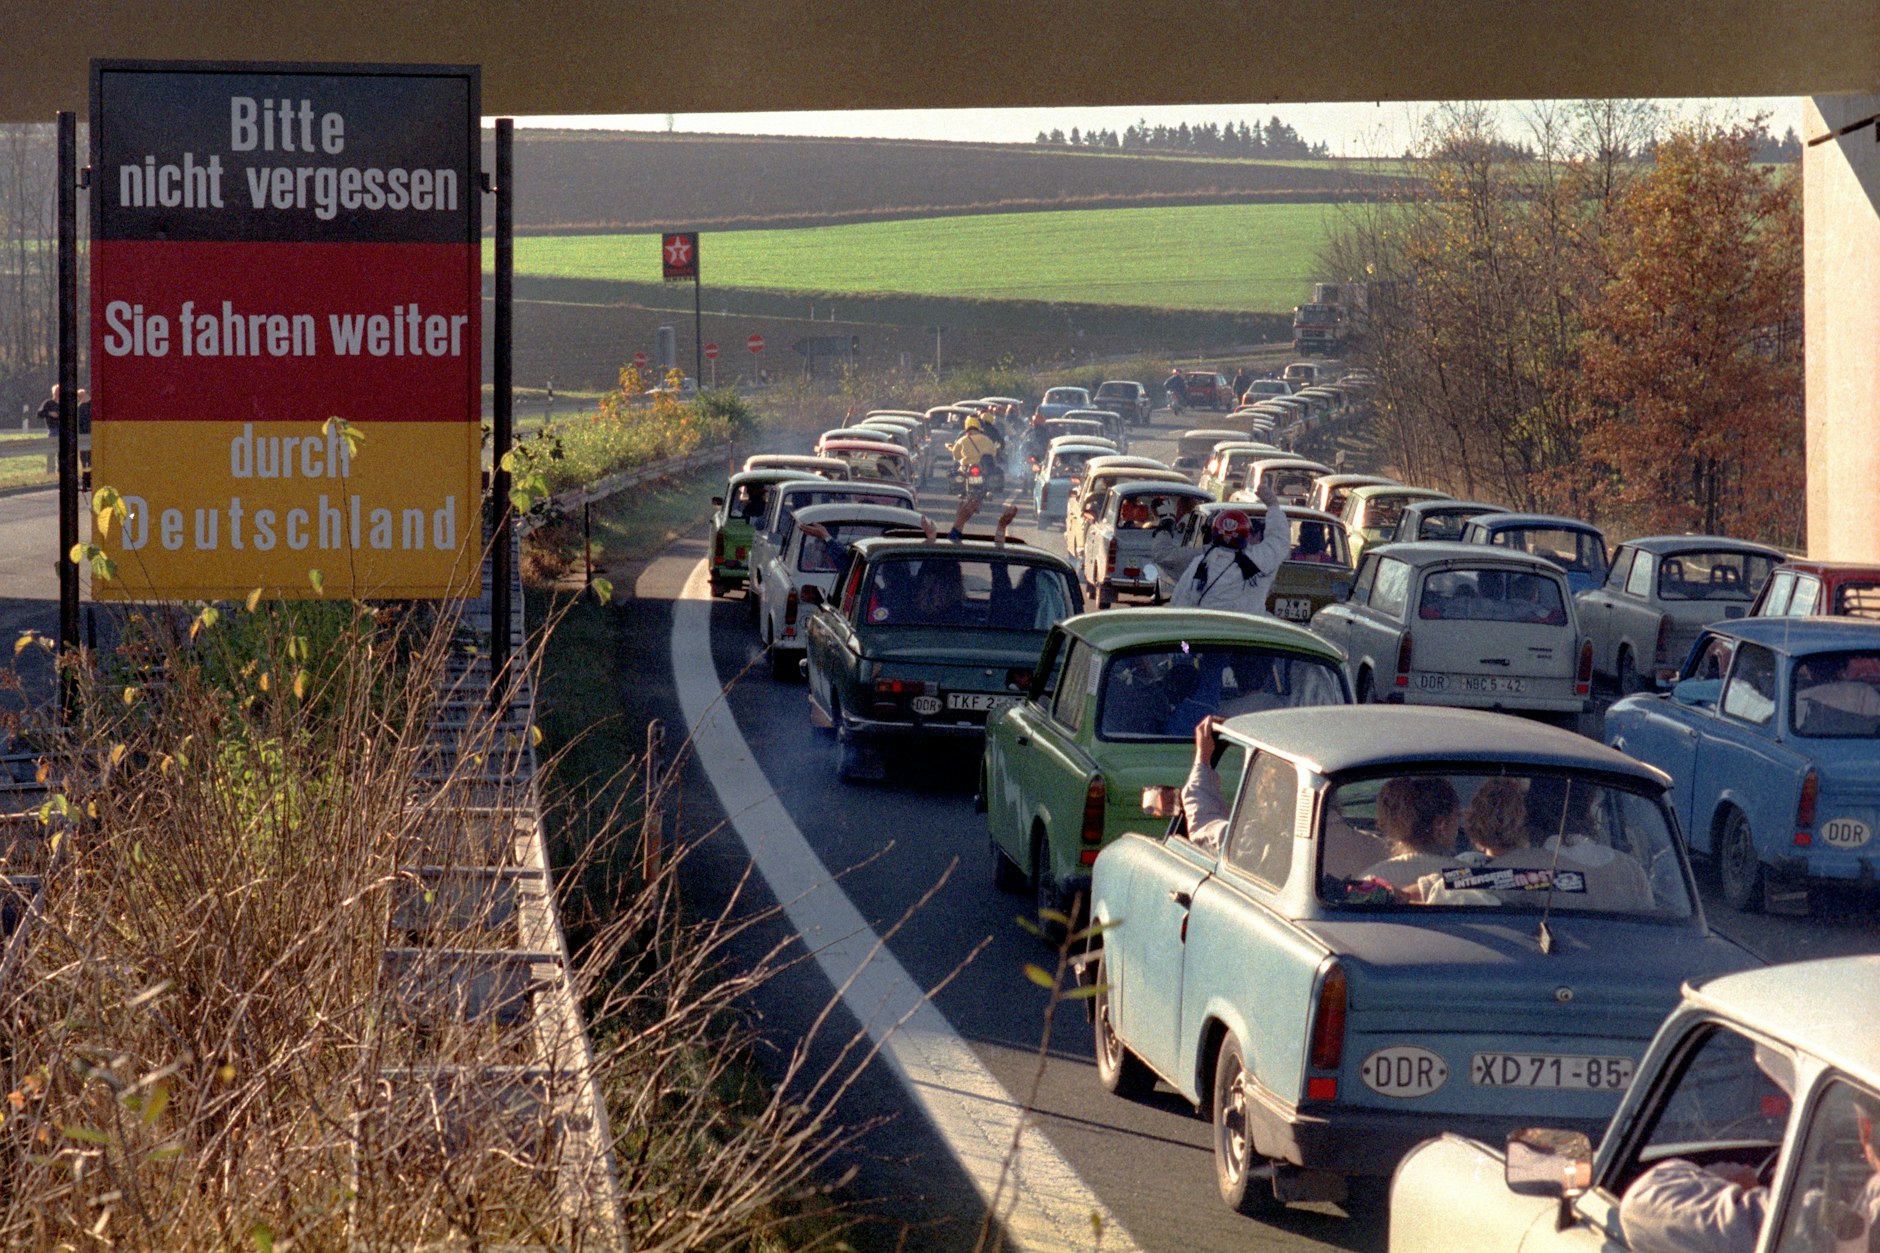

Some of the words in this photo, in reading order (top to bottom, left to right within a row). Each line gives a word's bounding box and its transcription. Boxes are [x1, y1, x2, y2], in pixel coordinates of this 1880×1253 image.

[231, 96, 345, 154] Bitte
[119, 152, 224, 208] nicht
[246, 166, 458, 220] vergessen
[104, 300, 170, 357] Sie
[179, 300, 316, 357] fahren
[328, 303, 468, 357] weiter
[230, 423, 351, 479] durch
[121, 495, 456, 551] Deutschland
[1420, 676, 1446, 690] DDR
[915, 700, 937, 711] DDR
[952, 694, 979, 708] TKF
[1828, 823, 1864, 843] DDR
[1375, 1056, 1434, 1088] DDR
[1479, 1055, 1521, 1085] XD
